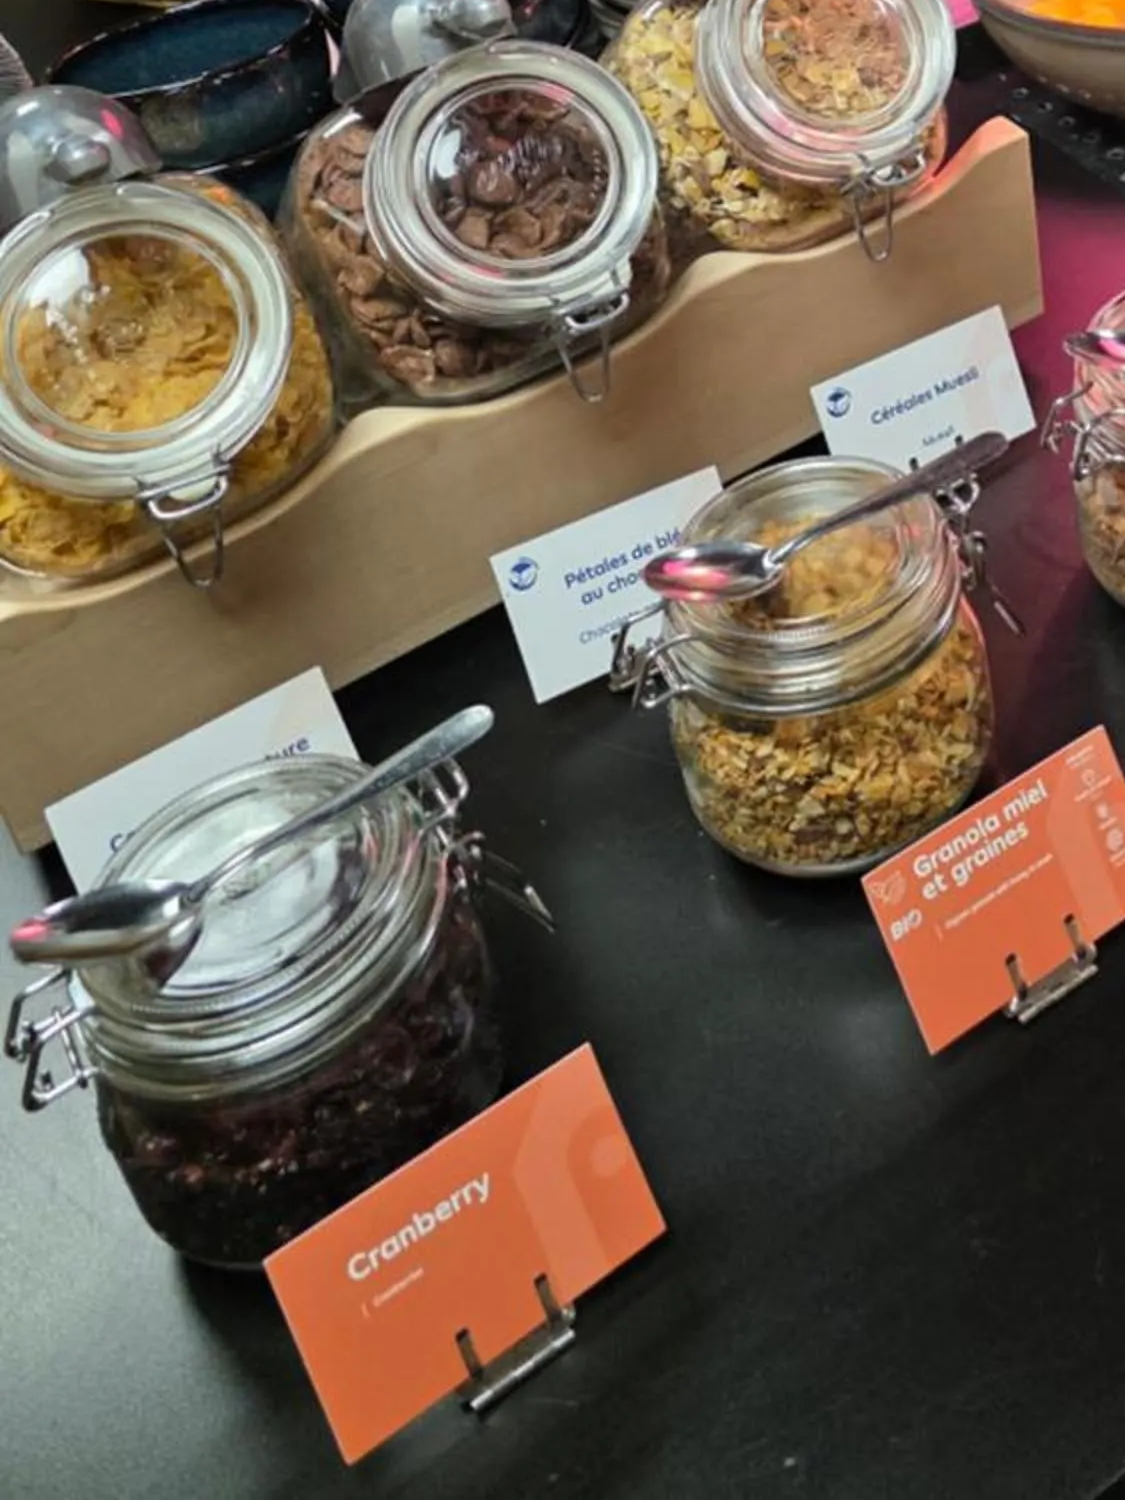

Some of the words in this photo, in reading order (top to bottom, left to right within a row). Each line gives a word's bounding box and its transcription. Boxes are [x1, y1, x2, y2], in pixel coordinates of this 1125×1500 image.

[870, 389, 933, 426] Céréales
[934, 365, 980, 396] Muesli
[564, 552, 629, 589] Pétales
[631, 542, 653, 560] de
[656, 527, 682, 551] blé
[581, 588, 604, 606] au
[607, 570, 643, 593] cho
[913, 817, 1000, 878] Granola
[1002, 779, 1048, 821] miel
[921, 871, 947, 900] et
[951, 819, 1029, 888] graines
[890, 908, 922, 941] BIO
[346, 1171, 490, 1281] Cranberry
